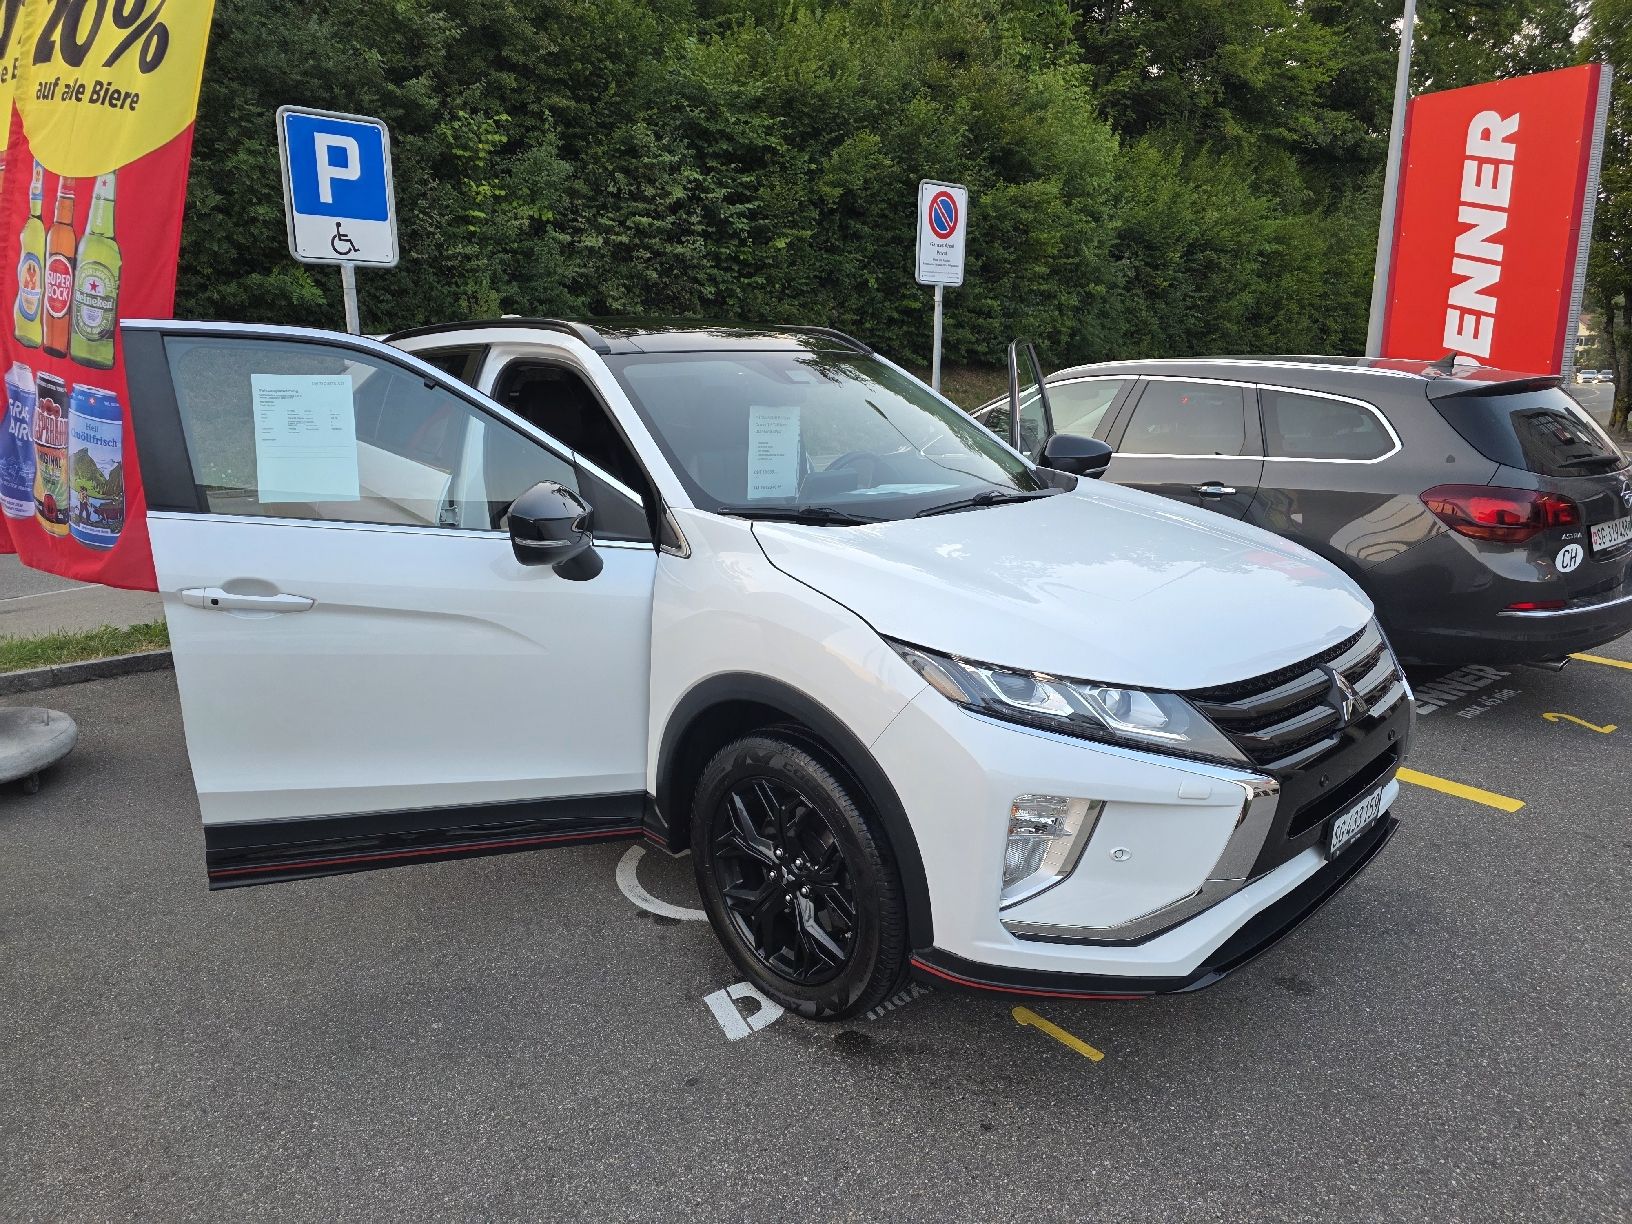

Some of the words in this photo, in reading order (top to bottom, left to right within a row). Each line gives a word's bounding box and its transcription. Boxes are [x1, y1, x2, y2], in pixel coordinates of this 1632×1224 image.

[32, 0, 169, 74] 20%
[36, 76, 60, 101] auf
[88, 79, 140, 112] Biere
[314, 132, 361, 204] P
[1442, 110, 1520, 367] ENNER
[85, 422, 99, 433] Hell
[1561, 547, 1578, 569] CH
[1541, 711, 1618, 735] 2
[1012, 1006, 1105, 1062] 1
